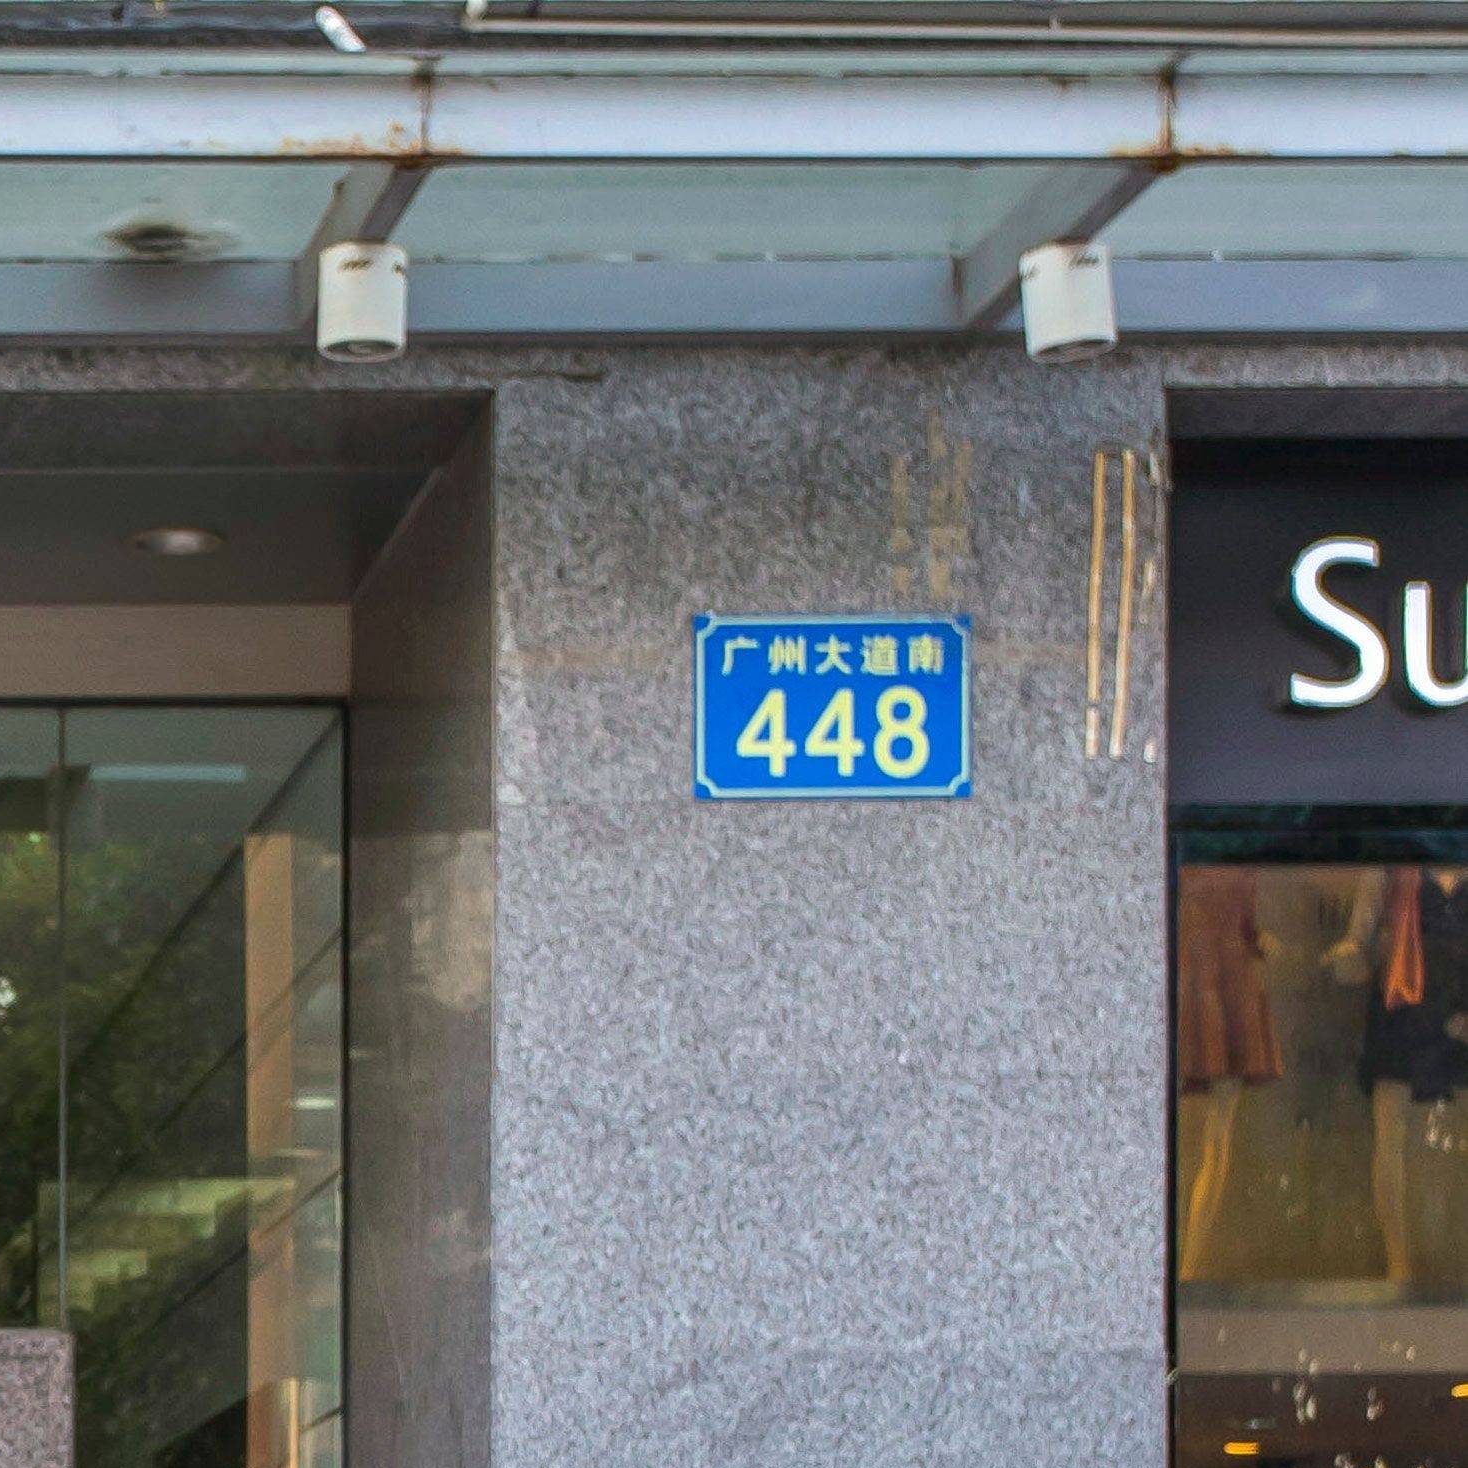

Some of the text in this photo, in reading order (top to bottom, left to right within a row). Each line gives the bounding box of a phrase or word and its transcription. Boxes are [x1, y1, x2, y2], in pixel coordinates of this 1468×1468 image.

[720, 633, 945, 677] 广州大道南
[1288, 535, 1468, 708] Su
[735, 684, 930, 779] 448
